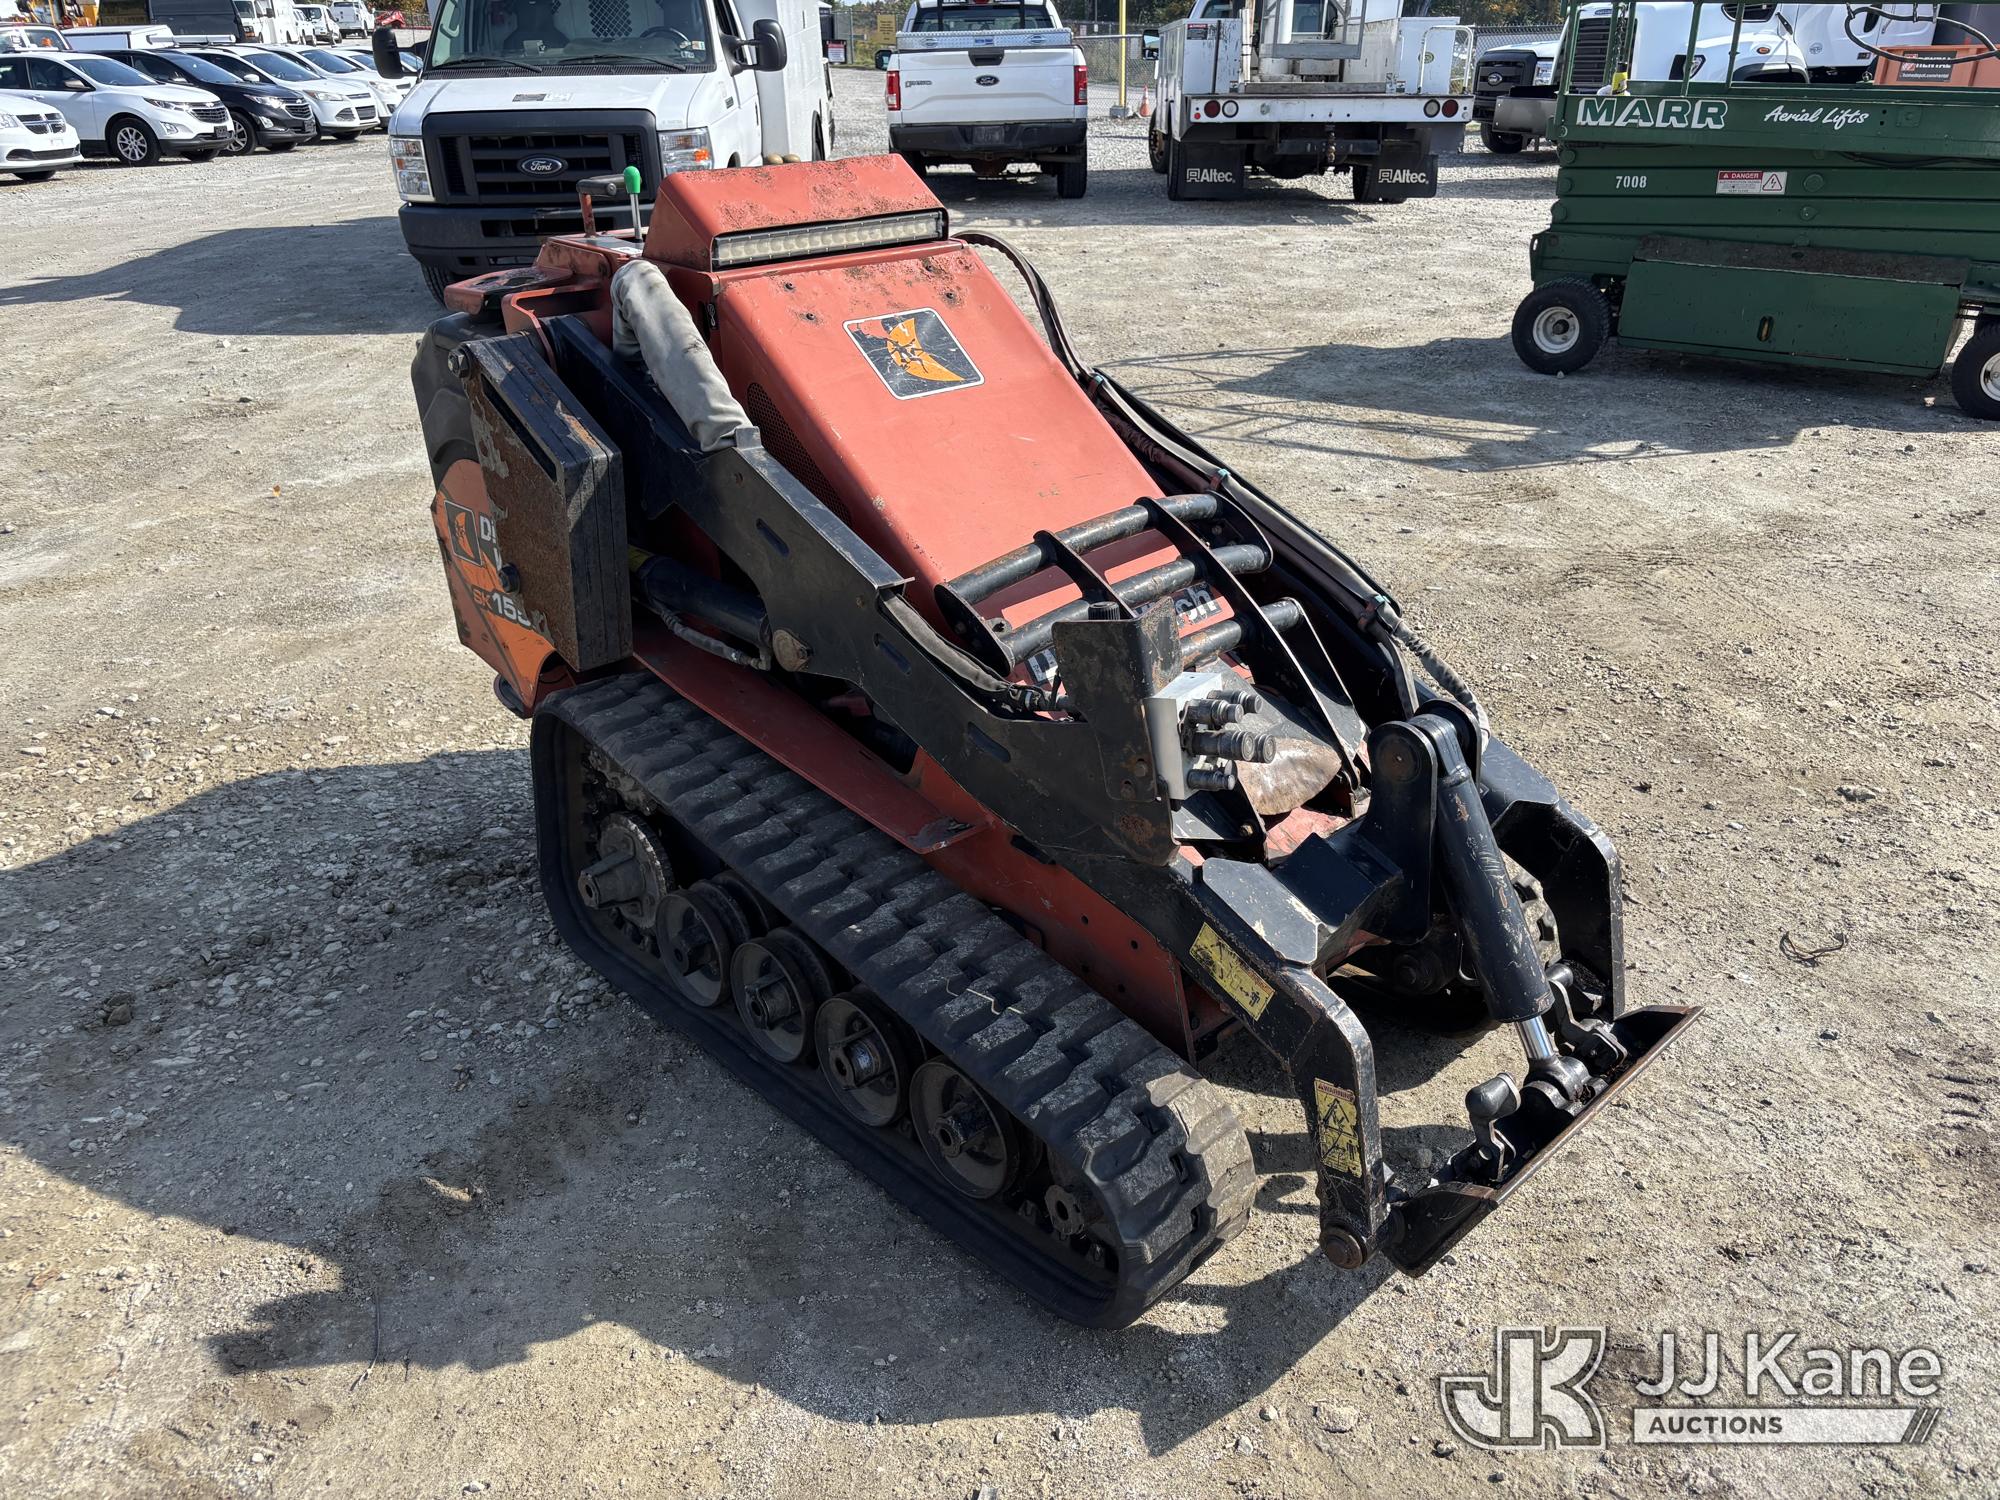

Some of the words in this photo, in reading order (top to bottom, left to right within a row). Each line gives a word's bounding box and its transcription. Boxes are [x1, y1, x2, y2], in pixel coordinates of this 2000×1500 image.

[1576, 97, 1729, 130] MARR
[1764, 104, 1820, 124] Aerial
[1822, 106, 1871, 130] Lifts
[529, 160, 553, 173] Ford
[1200, 168, 1233, 184] Altec
[1392, 168, 1426, 184] Altec
[1615, 175, 1648, 189] 7008
[1731, 172, 1759, 180] DANGER
